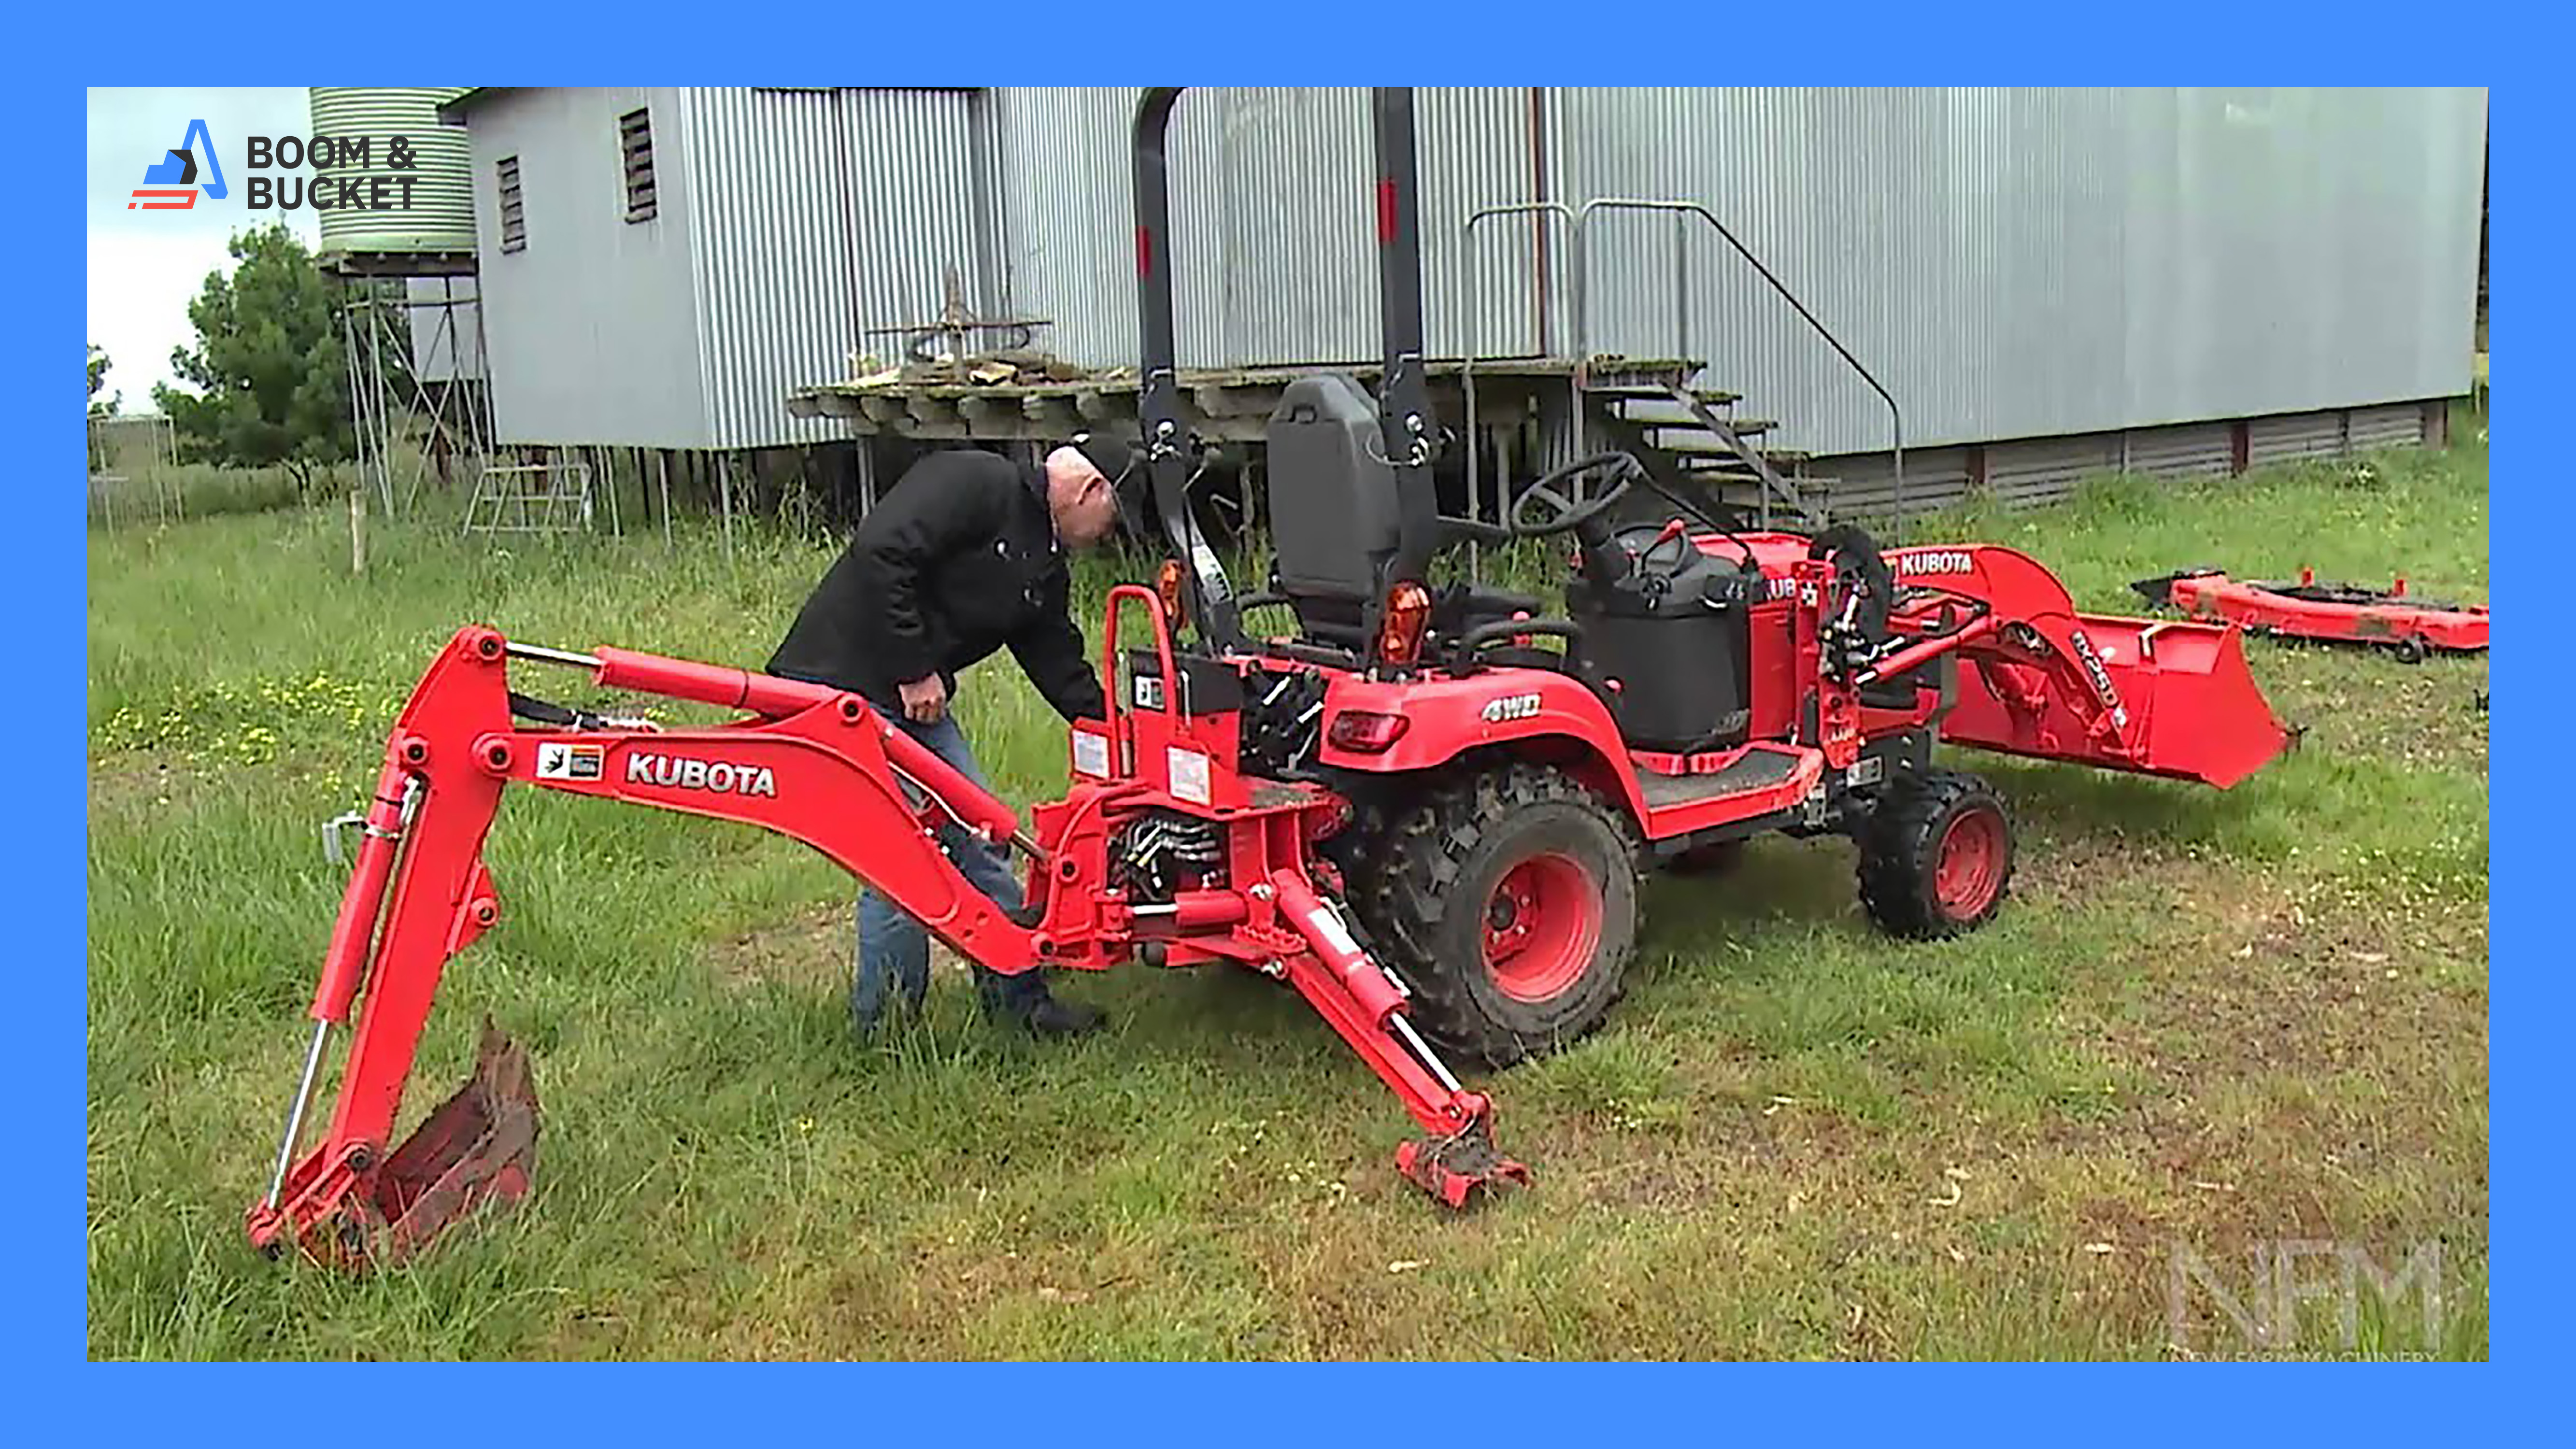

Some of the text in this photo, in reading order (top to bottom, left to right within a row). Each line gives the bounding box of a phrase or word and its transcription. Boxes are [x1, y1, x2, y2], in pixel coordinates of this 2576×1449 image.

[1901, 551, 1973, 575] KUBOTA
[1481, 693, 1541, 722] 4WD
[626, 752, 776, 797] KUBOTA
